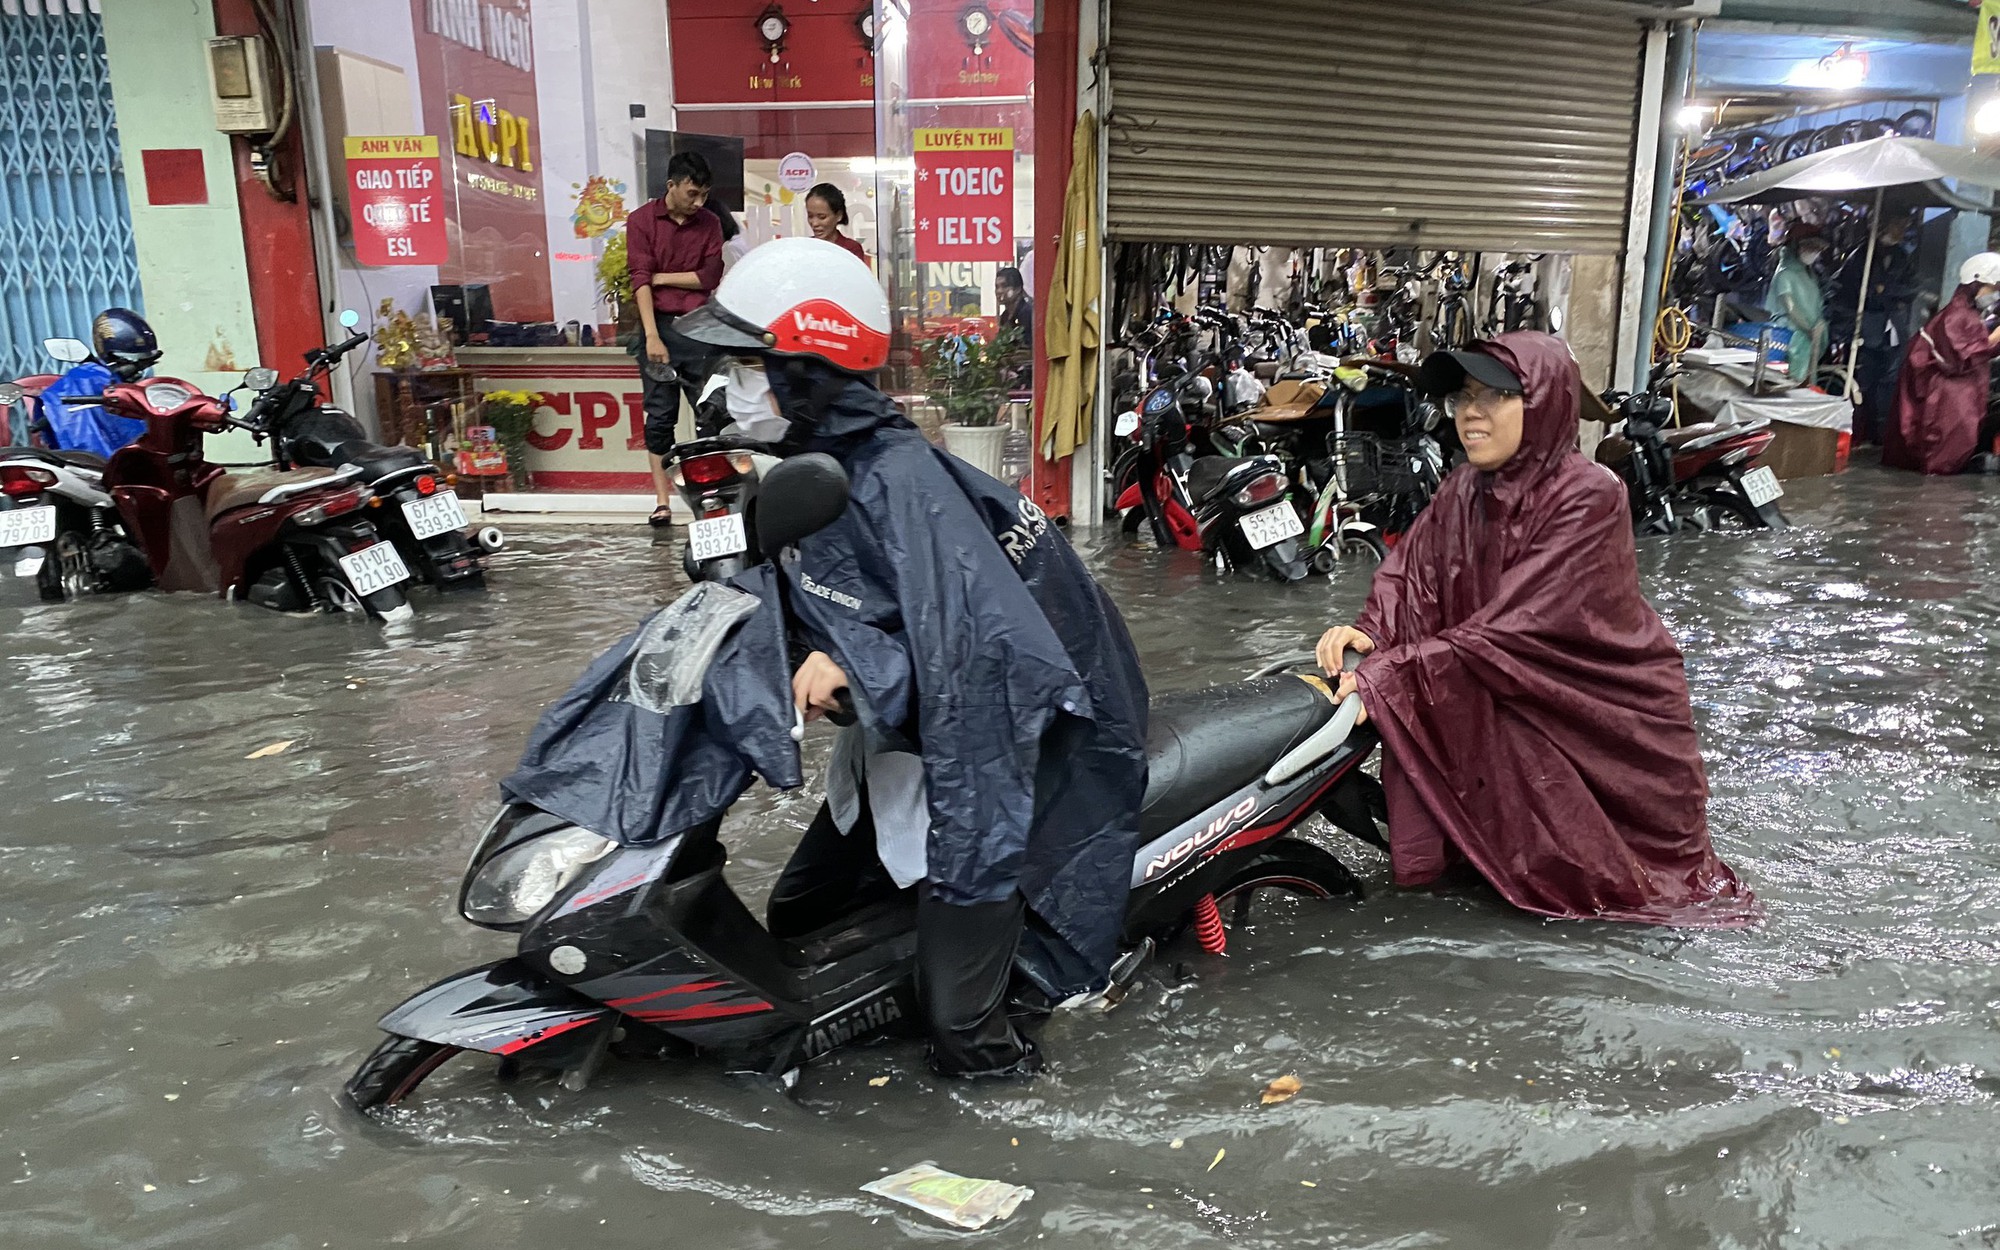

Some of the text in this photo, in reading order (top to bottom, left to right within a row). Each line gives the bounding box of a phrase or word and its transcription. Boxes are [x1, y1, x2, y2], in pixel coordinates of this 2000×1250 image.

[958, 70, 1000, 87] Sydney
[454, 93, 534, 172] ACPI
[925, 130, 1003, 149] LUYỆN THI
[361, 138, 422, 153] ANH VĂN
[356, 161, 433, 189] GIAO TIẾP
[935, 167, 1004, 195] TOEIC
[409, 196, 431, 222] TẾ
[937, 216, 1002, 245] IELTS
[387, 238, 417, 256] ESL
[793, 310, 860, 338] VinMart
[7, 510, 46, 528] 59-S3
[411, 496, 451, 519] 67-E1
[2, 524, 50, 544] 797.03
[414, 511, 462, 535] 539.31
[696, 517, 736, 540] 59-F2
[695, 534, 742, 557] 393.24
[350, 547, 391, 573] 61-D2
[355, 562, 404, 592] 221.90
[830, 590, 863, 610] UNION
[1145, 796, 1256, 878] NOUVO
[802, 996, 902, 1058] YAMAHA
